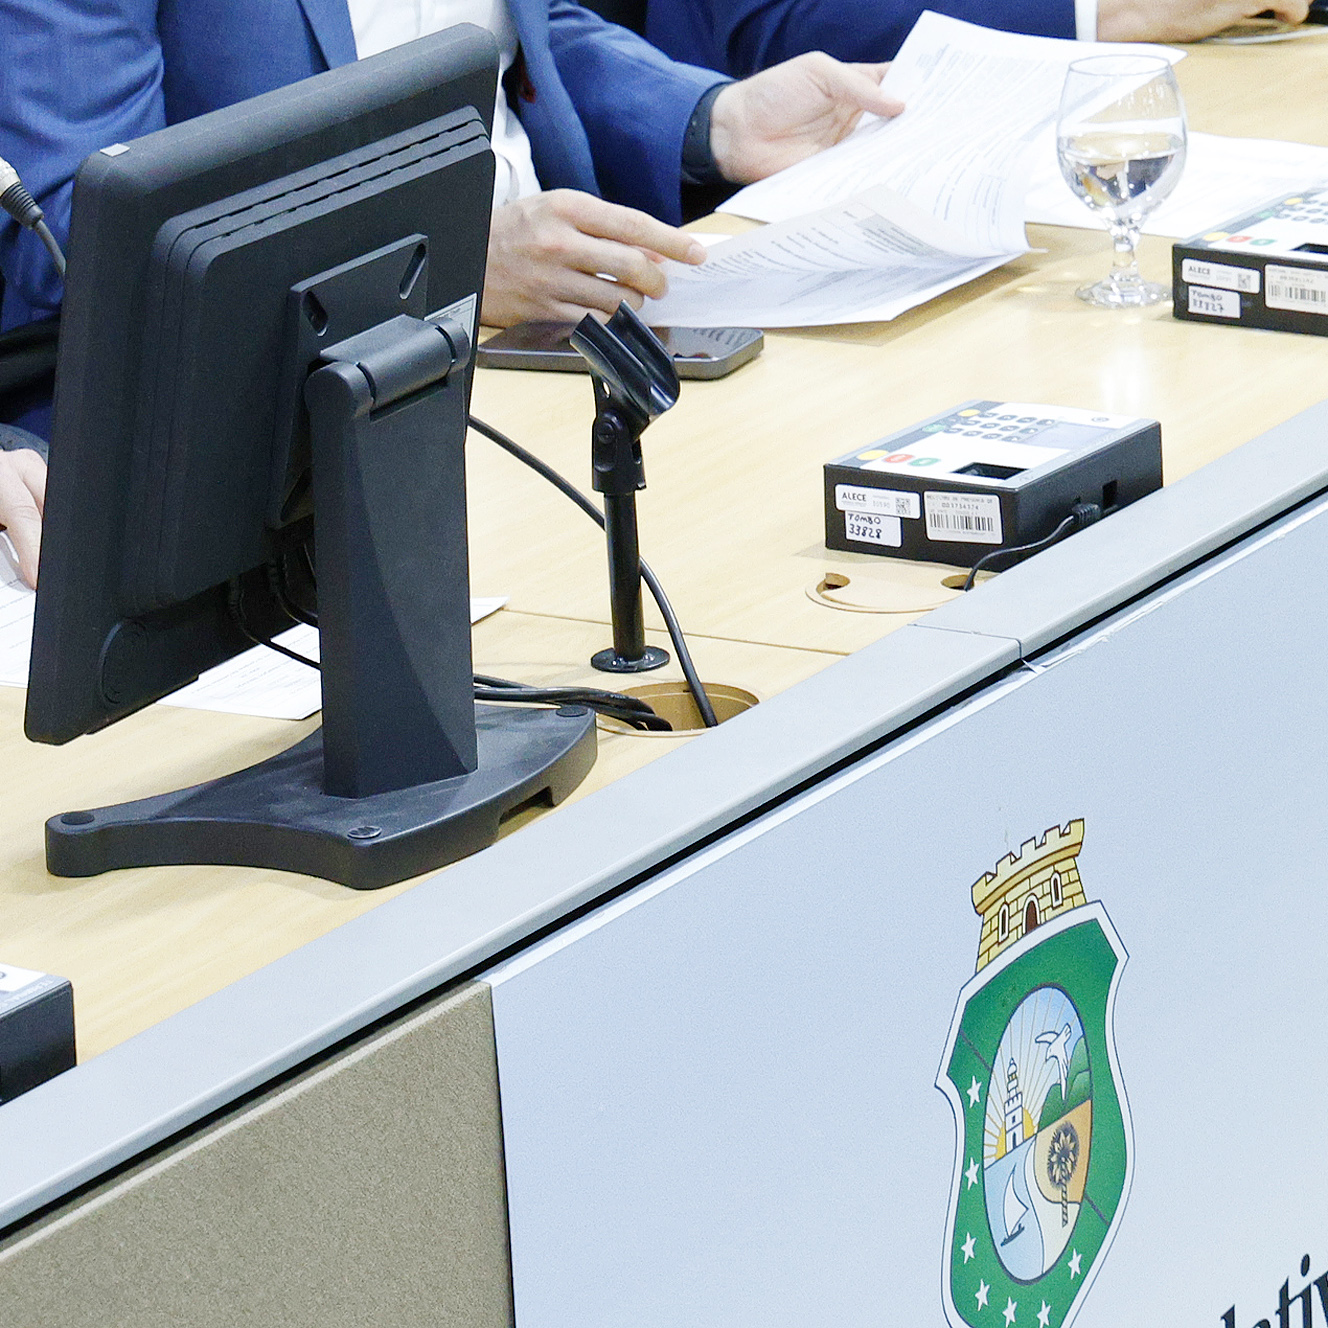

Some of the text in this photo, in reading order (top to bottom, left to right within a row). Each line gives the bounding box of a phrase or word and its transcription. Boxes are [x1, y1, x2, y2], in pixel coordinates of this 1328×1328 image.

[842, 492, 866, 501] ALECE
[848, 514, 881, 524] TOMBO
[849, 524, 882, 539] 33828
